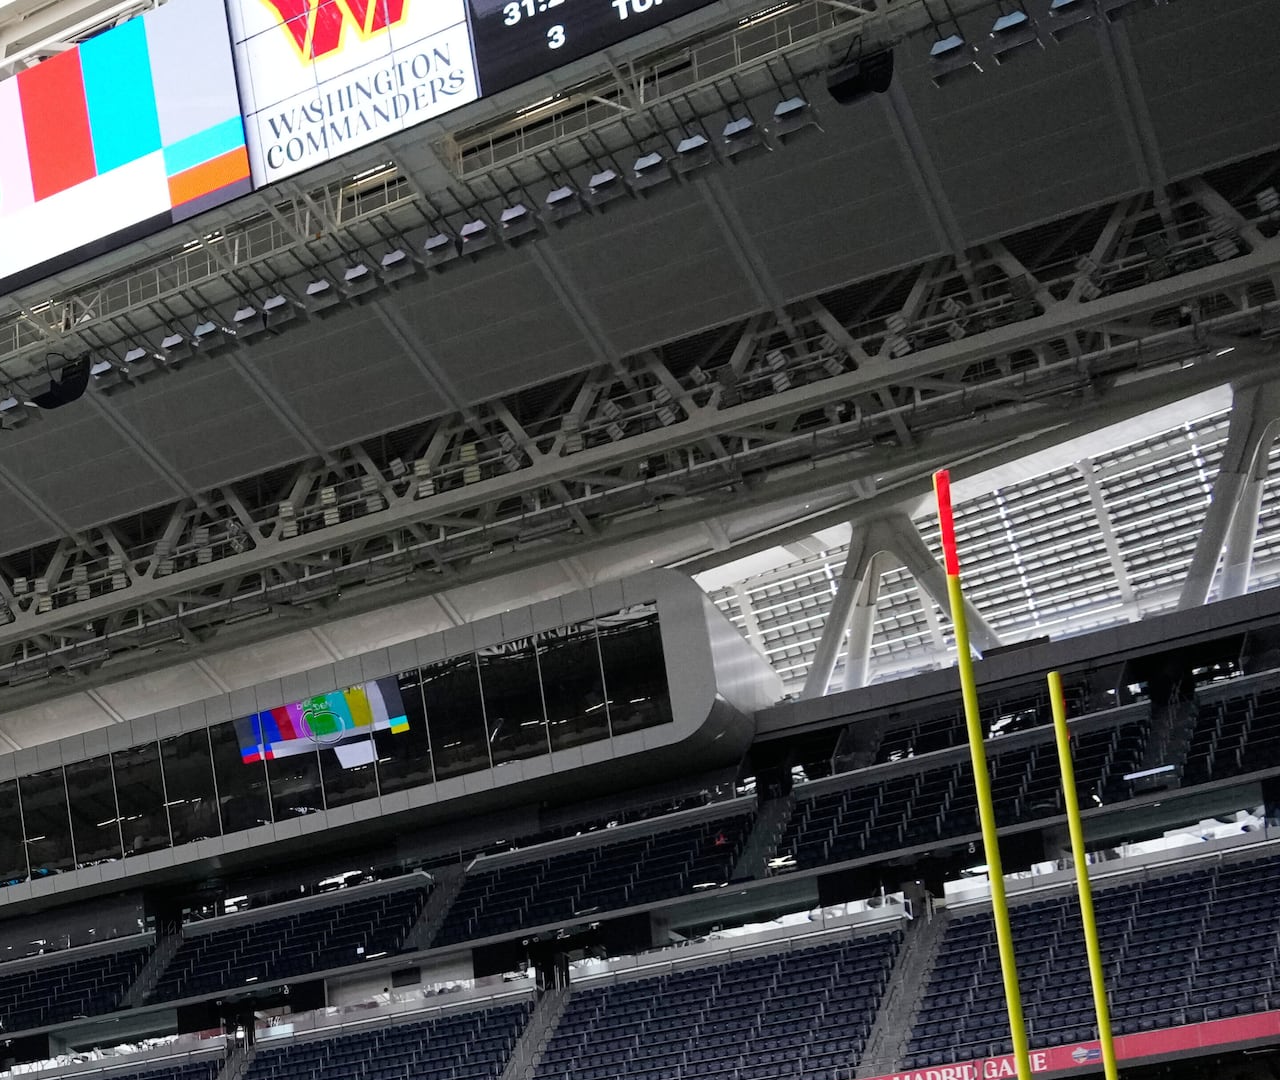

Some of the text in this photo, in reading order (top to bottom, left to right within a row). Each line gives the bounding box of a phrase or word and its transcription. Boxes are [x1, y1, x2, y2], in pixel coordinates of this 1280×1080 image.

[546, 24, 566, 49] 3
[267, 42, 452, 140] WASHINGTON
[267, 69, 466, 170] COMMANDERS
[983, 1052, 1048, 1078] GAE
